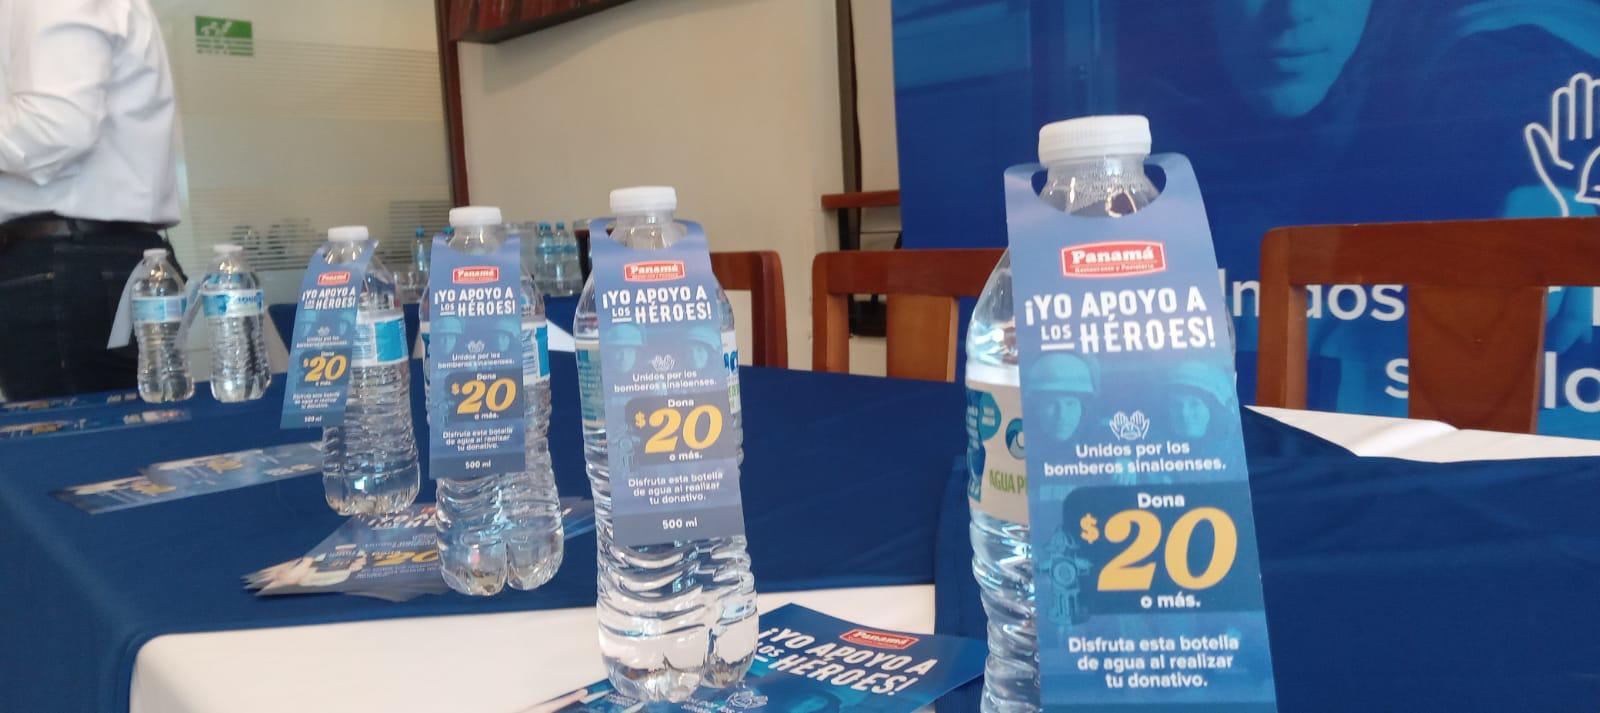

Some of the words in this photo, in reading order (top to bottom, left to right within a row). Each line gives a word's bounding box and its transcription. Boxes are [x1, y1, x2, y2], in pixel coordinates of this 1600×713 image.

[1071, 246, 1154, 264] Panamá
[630, 264, 678, 274] Panamá
[319, 286, 349, 298] APOYO
[349, 285, 356, 296] A
[435, 290, 455, 305] ¡YO
[459, 287, 502, 301] APOYO
[505, 286, 514, 299] A
[602, 289, 630, 309] ¡YO
[635, 286, 691, 305] APOYO
[695, 285, 708, 300] A
[440, 303, 455, 312] LOS
[458, 298, 516, 317] HÉROES!
[612, 308, 631, 317] LOS
[635, 301, 712, 324] HÉROES!
[1024, 294, 1071, 326] ¡YO
[1080, 287, 1177, 318] APOYO
[1186, 286, 1207, 311] A
[1040, 324, 1072, 341] LOS
[1080, 313, 1216, 354] HÉROES!
[632, 373, 665, 382] Unidos
[667, 373, 681, 383] por
[683, 370, 697, 380] los
[451, 378, 517, 415] $20
[614, 382, 659, 393] bomberos
[667, 399, 695, 408] Dona
[634, 404, 723, 454] $20
[669, 454, 676, 462] o
[678, 452, 703, 461] más.
[1075, 443, 1131, 458] Unidos
[1135, 443, 1161, 460] por
[1167, 441, 1190, 454] los
[1044, 461, 1123, 477] bomberos
[1127, 458, 1226, 474] sinaloenses.
[628, 478, 666, 488] Disfruta
[668, 476, 689, 485] esta
[691, 472, 723, 482] botella
[989, 469, 1016, 494] AGUA
[634, 488, 646, 497] de
[648, 487, 672, 498] agua
[674, 485, 683, 494] al
[686, 482, 720, 493] realizar
[649, 497, 660, 505] tu
[662, 493, 706, 504] donativo.
[1137, 492, 1185, 508] Dona
[662, 519, 683, 530] 500
[685, 517, 698, 528] ml
[1080, 506, 1238, 592] $20
[1140, 597, 1152, 608] o
[1157, 593, 1201, 608] más.
[1068, 637, 1135, 653] Disfruta
[1139, 638, 1175, 652] esta
[1180, 634, 1239, 651] botella
[804, 641, 913, 672] APOYO
[904, 658, 938, 675] A
[1077, 656, 1098, 670] de
[1103, 658, 1145, 673] agua
[1150, 654, 1165, 669] al
[1170, 652, 1233, 669] realizar
[768, 654, 919, 696] HÉROES!
[1105, 674, 1123, 689] tu
[1128, 672, 1208, 688] donativo.
